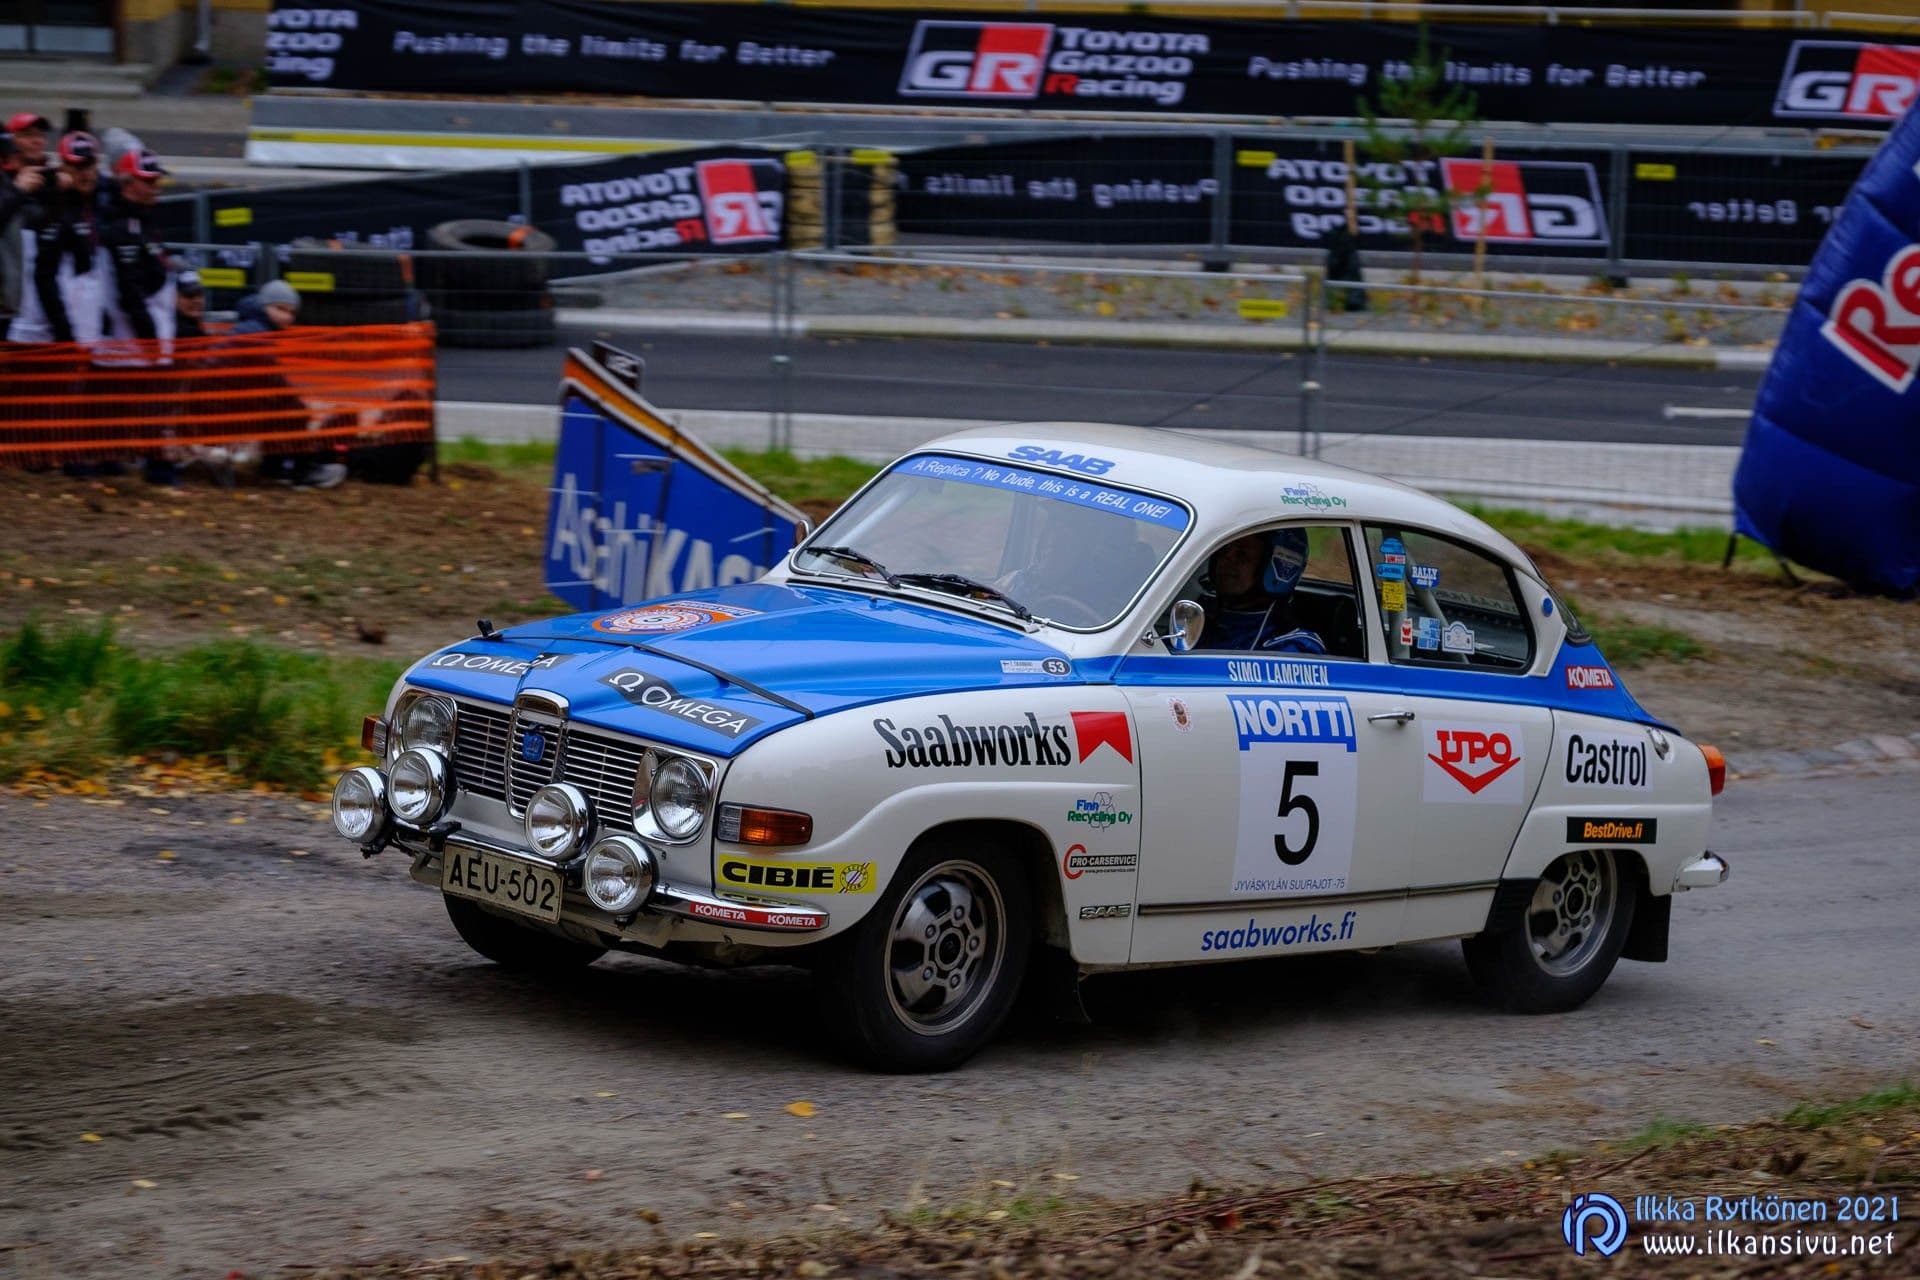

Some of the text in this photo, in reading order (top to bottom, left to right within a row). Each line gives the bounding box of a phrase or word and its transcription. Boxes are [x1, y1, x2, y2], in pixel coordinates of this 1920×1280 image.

[1057, 27, 1210, 53] TOYOTA
[909, 50, 1038, 91] GR
[1050, 51, 1194, 75] GAZOO
[1247, 56, 1368, 85] Pushing
[1605, 64, 1707, 88] Better
[1044, 73, 1187, 105] Racing
[1008, 446, 1116, 475] SAAB
[912, 460, 926, 471] A
[924, 461, 970, 476] Replica
[981, 469, 1000, 481] No
[1002, 472, 1035, 489] Dude,
[1038, 480, 1063, 494] this
[1064, 485, 1080, 497] is
[1079, 490, 1091, 499] a
[1092, 491, 1130, 510] REAL
[1132, 501, 1172, 519] ONE!
[1047, 661, 1065, 673] 53
[1228, 661, 1329, 686] SIMO LAMPINEN
[1567, 667, 1613, 688] KOMETA
[641, 686, 748, 734] OMEGA
[1232, 700, 1353, 737] NORTTI
[873, 711, 1071, 768] Saabworks
[1436, 730, 1512, 764] UPO
[1566, 734, 1646, 786] Castrol
[1067, 811, 1133, 824] Recycling Oy
[1076, 800, 1099, 811] Finn
[1274, 760, 1320, 865] 5
[1583, 822, 1642, 839] BestDrive.fi
[449, 853, 555, 912] AEU-502
[1289, 879, 1332, 890] SUURAJOT
[695, 903, 817, 927] KOMETA KOMETA
[1201, 911, 1357, 951] saabworks.fi
